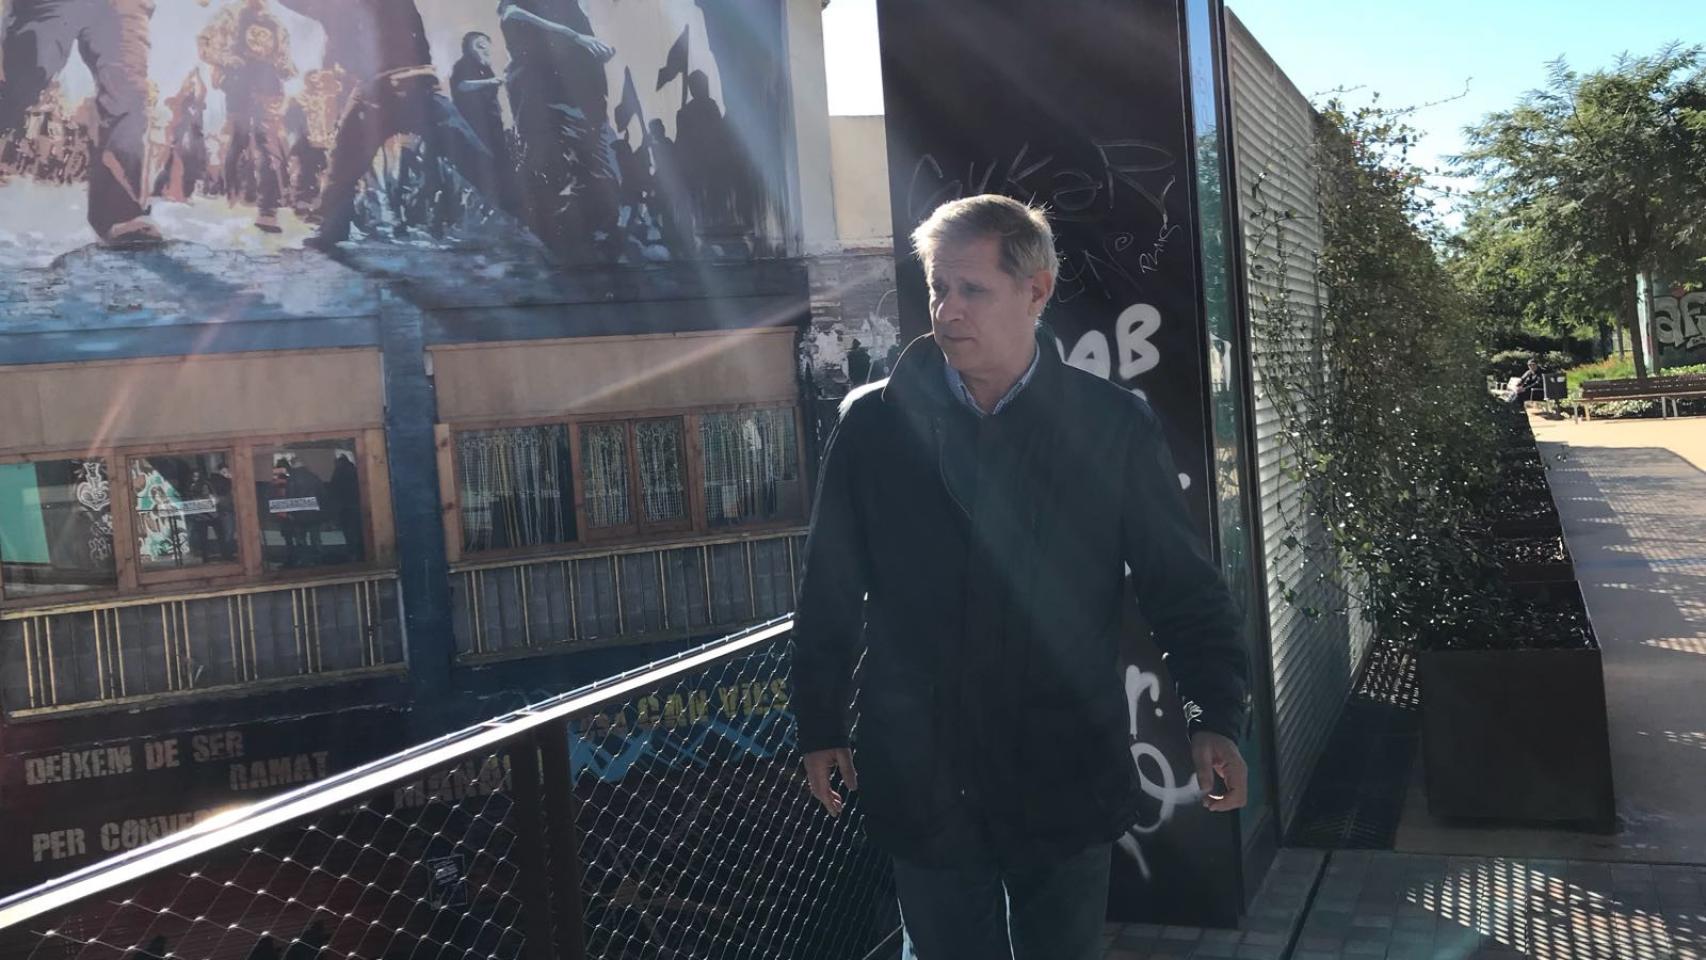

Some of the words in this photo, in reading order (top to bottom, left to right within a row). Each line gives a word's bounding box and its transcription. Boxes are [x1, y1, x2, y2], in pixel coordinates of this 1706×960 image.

[25, 746, 133, 785] DEIXEM
[145, 738, 180, 771] DE
[192, 729, 245, 763] SER
[229, 751, 330, 791] RAMAT
[32, 828, 87, 863] PER
